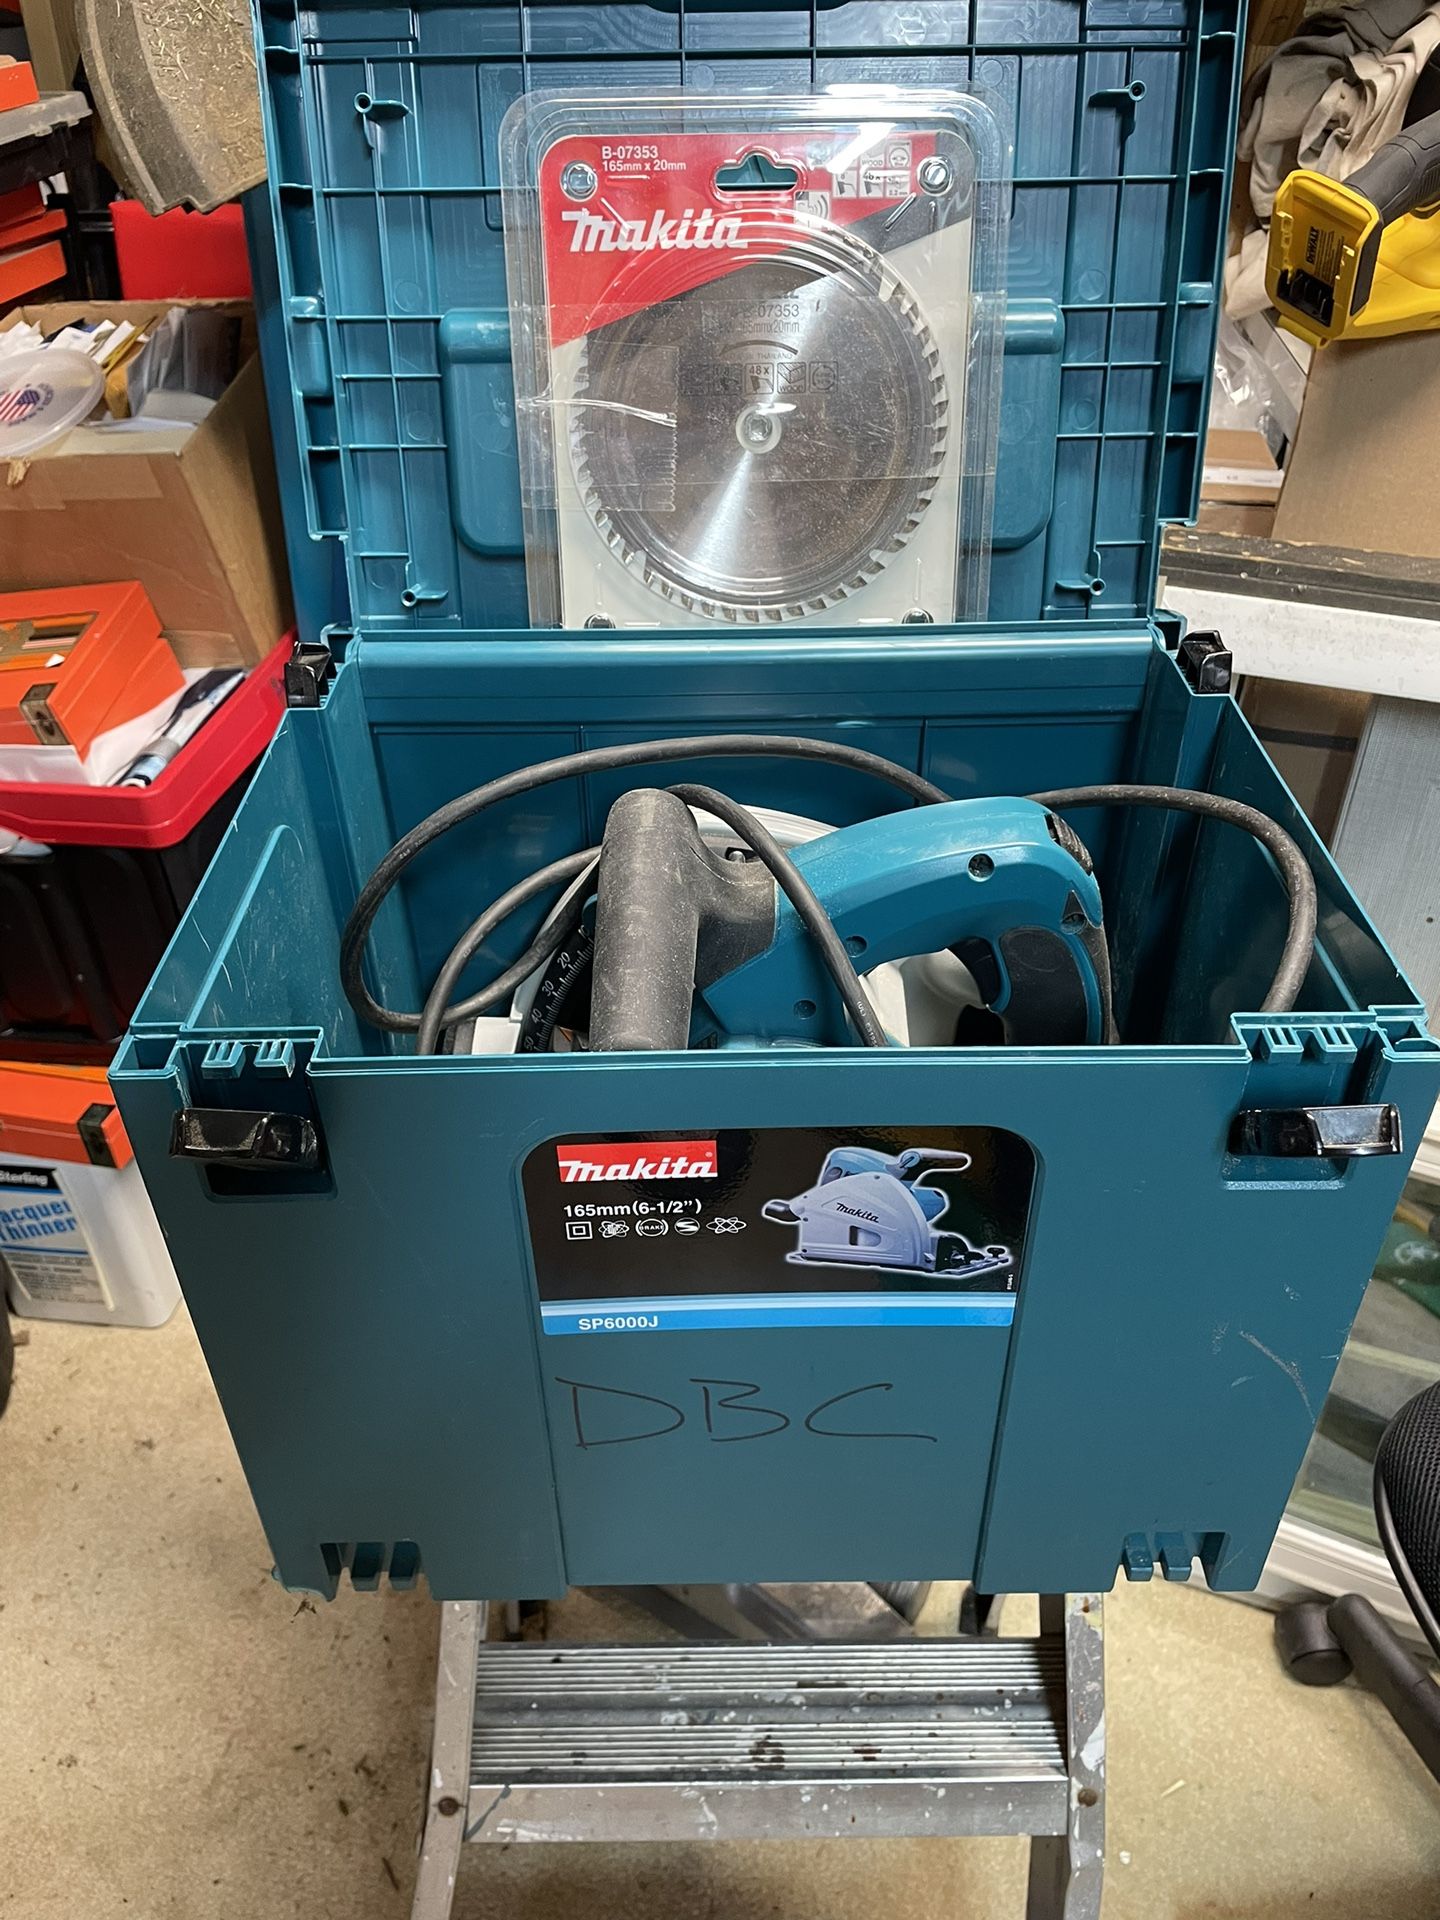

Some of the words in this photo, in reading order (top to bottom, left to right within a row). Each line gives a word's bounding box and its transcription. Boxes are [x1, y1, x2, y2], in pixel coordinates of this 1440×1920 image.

[602, 146, 659, 160] B-07353
[602, 160, 642, 172] 165mm
[644, 162, 651, 172] x
[653, 159, 687, 172] 20mm
[557, 951, 571, 969] 20
[542, 979, 555, 997] 30
[531, 1007, 543, 1024] 40
[578, 1315, 659, 1331] SP6000J
